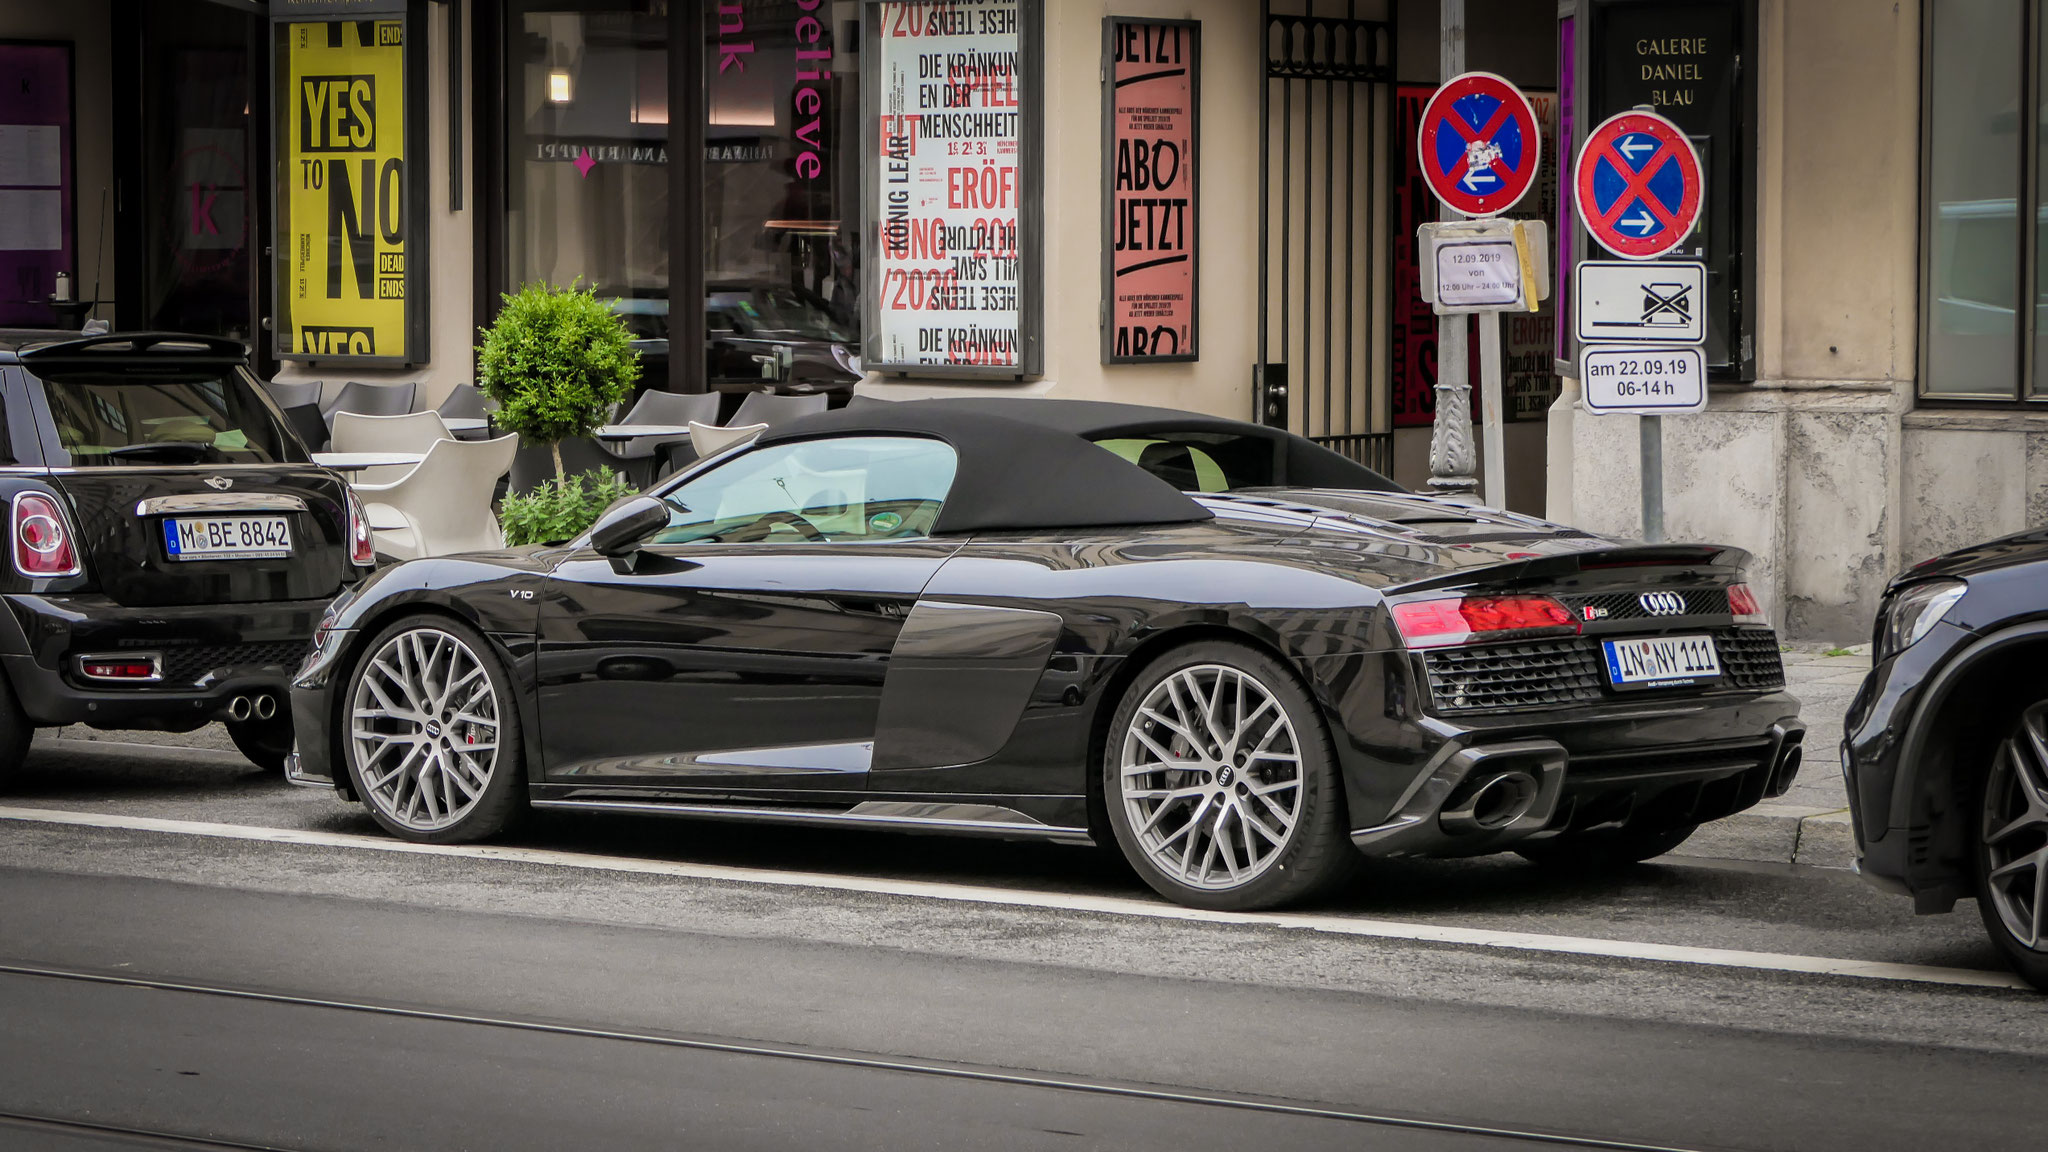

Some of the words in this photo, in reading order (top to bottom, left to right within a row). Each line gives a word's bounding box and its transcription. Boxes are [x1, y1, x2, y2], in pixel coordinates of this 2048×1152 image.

[380, 26, 402, 44] END
[1636, 38, 1707, 55] GALERIE
[919, 54, 942, 78] DIE
[1641, 64, 1703, 80] DANIEL
[919, 84, 938, 108] EN
[943, 83, 971, 108] DER
[1652, 90, 1694, 106] BLAU
[303, 79, 372, 148] YES
[920, 112, 1018, 138] MENSCHHEIT
[888, 136, 909, 183] LEAR
[1116, 139, 1179, 191] ABO
[301, 159, 323, 190] TO
[884, 191, 909, 250] KÖNIG
[1115, 199, 1188, 251] JETZT
[381, 254, 404, 272] DEAD
[951, 256, 987, 281] SAVE
[1453, 253, 1501, 263] 12.09.2019
[381, 280, 404, 297] ENDS
[1502, 281, 1515, 289] Uhr
[919, 328, 942, 352] DIE
[1590, 364, 1615, 376] am
[1619, 359, 1687, 376] 22.09.19
[1617, 380, 1661, 396] 06-14
[1664, 381, 1674, 395] h
[179, 523, 196, 549] M
[208, 522, 237, 547] BE
[240, 521, 288, 547] 8842
[1620, 645, 1646, 676] IN
[1653, 642, 1678, 674] NY
[1680, 641, 1715, 672] 111
